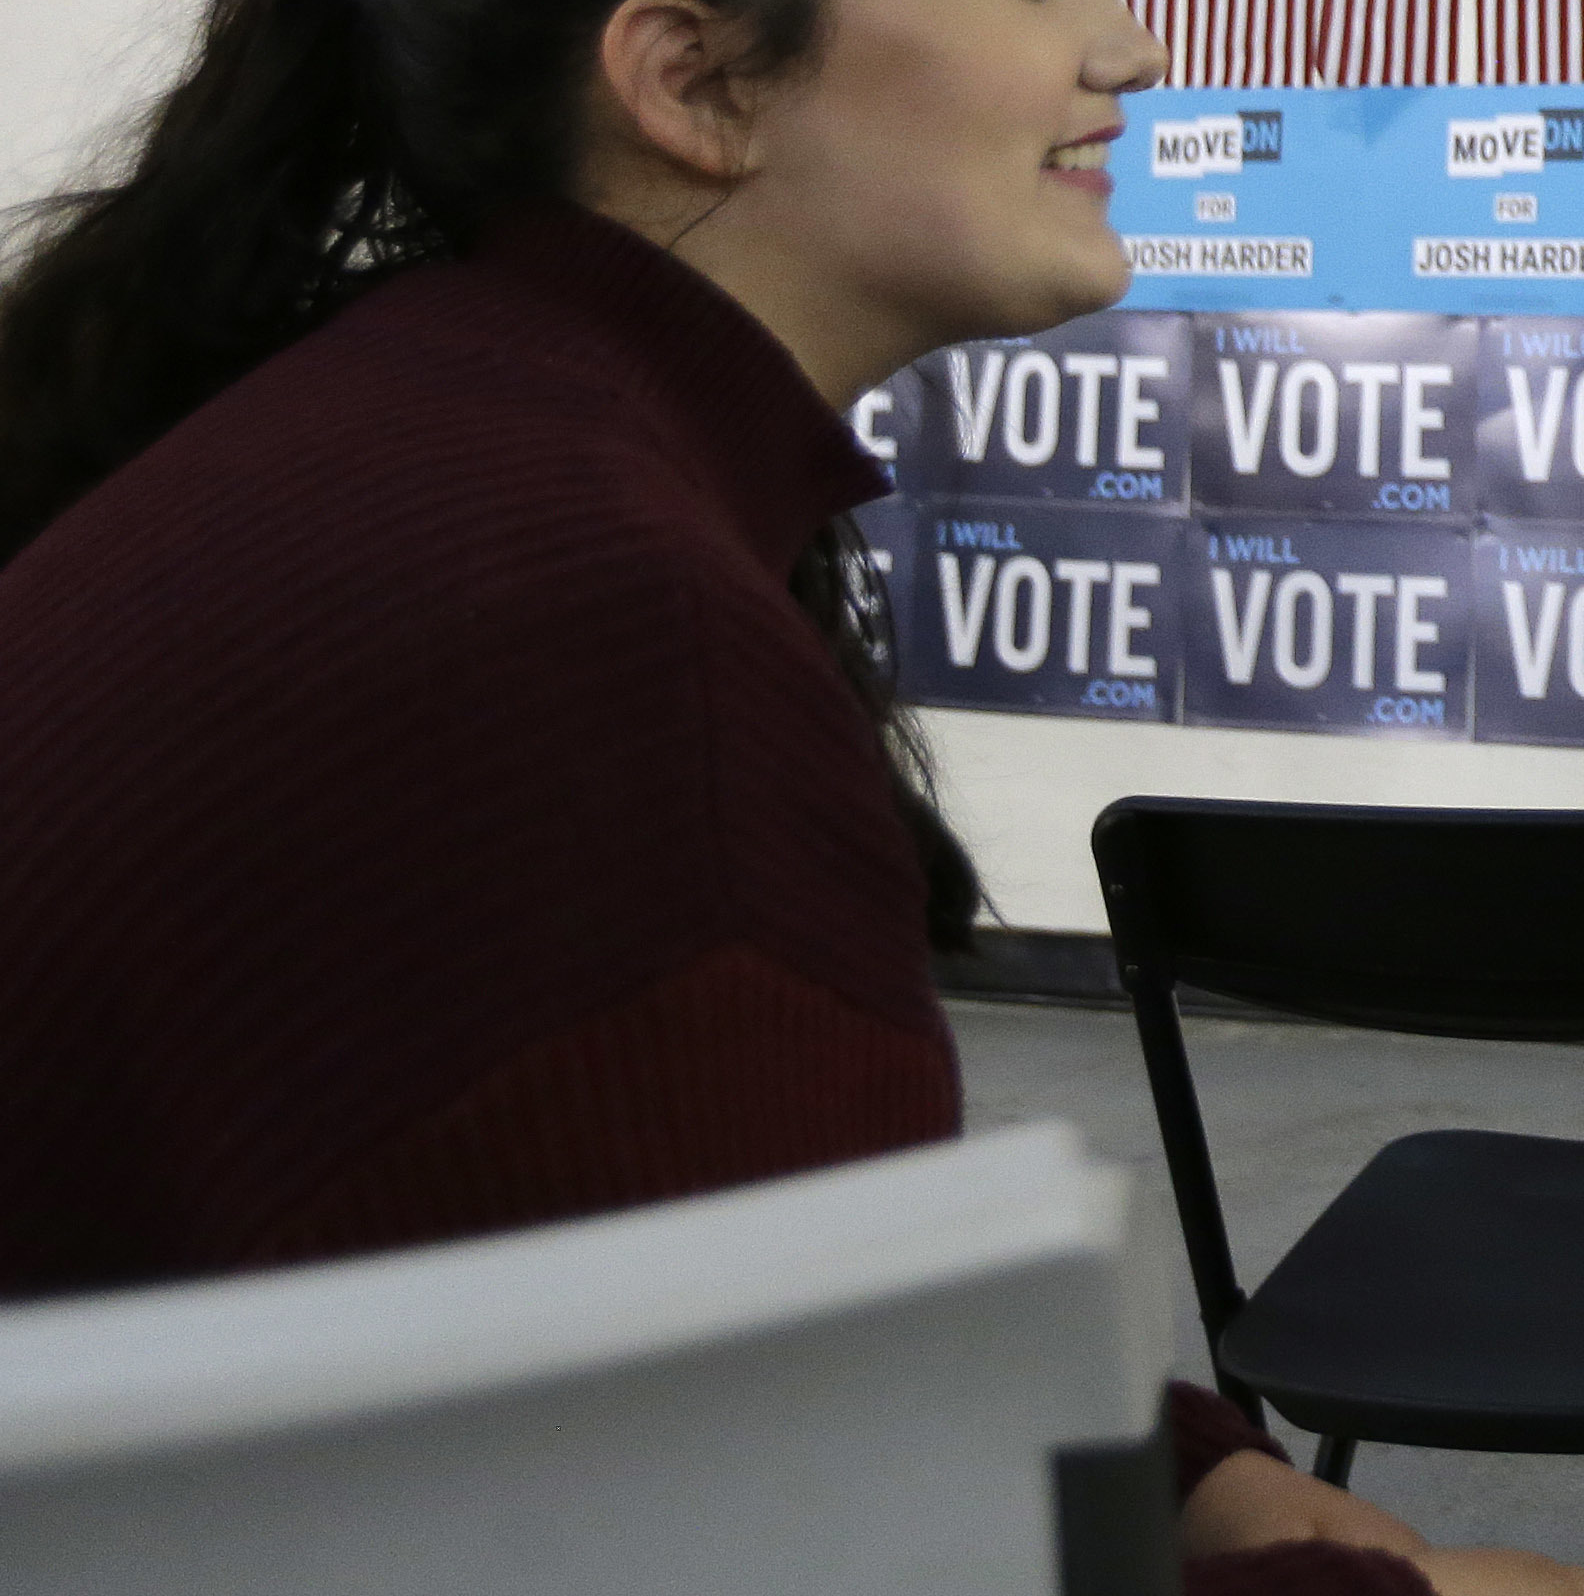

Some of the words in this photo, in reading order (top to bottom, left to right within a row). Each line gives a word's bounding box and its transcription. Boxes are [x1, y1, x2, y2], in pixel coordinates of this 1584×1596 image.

[1199, 197, 1230, 216] FOR
[1498, 198, 1532, 218] FOR
[1200, 242, 1307, 272] HARDER
[1419, 243, 1490, 271] JOSH
[1216, 327, 1225, 353] I
[1233, 327, 1304, 354] WILL
[949, 349, 1169, 469] VOTE
[1219, 359, 1452, 479] VOTE
[1089, 472, 1163, 501] .COM
[1371, 483, 1450, 510] .COM
[936, 520, 947, 545] I
[953, 522, 1022, 550] WILL
[1208, 535, 1218, 561] I
[1226, 535, 1300, 564] WILL
[936, 550, 1160, 679] VOTE
[1211, 567, 1448, 693] VOTE
[1080, 680, 1156, 707] .COM
[1366, 697, 1445, 725] .COM
